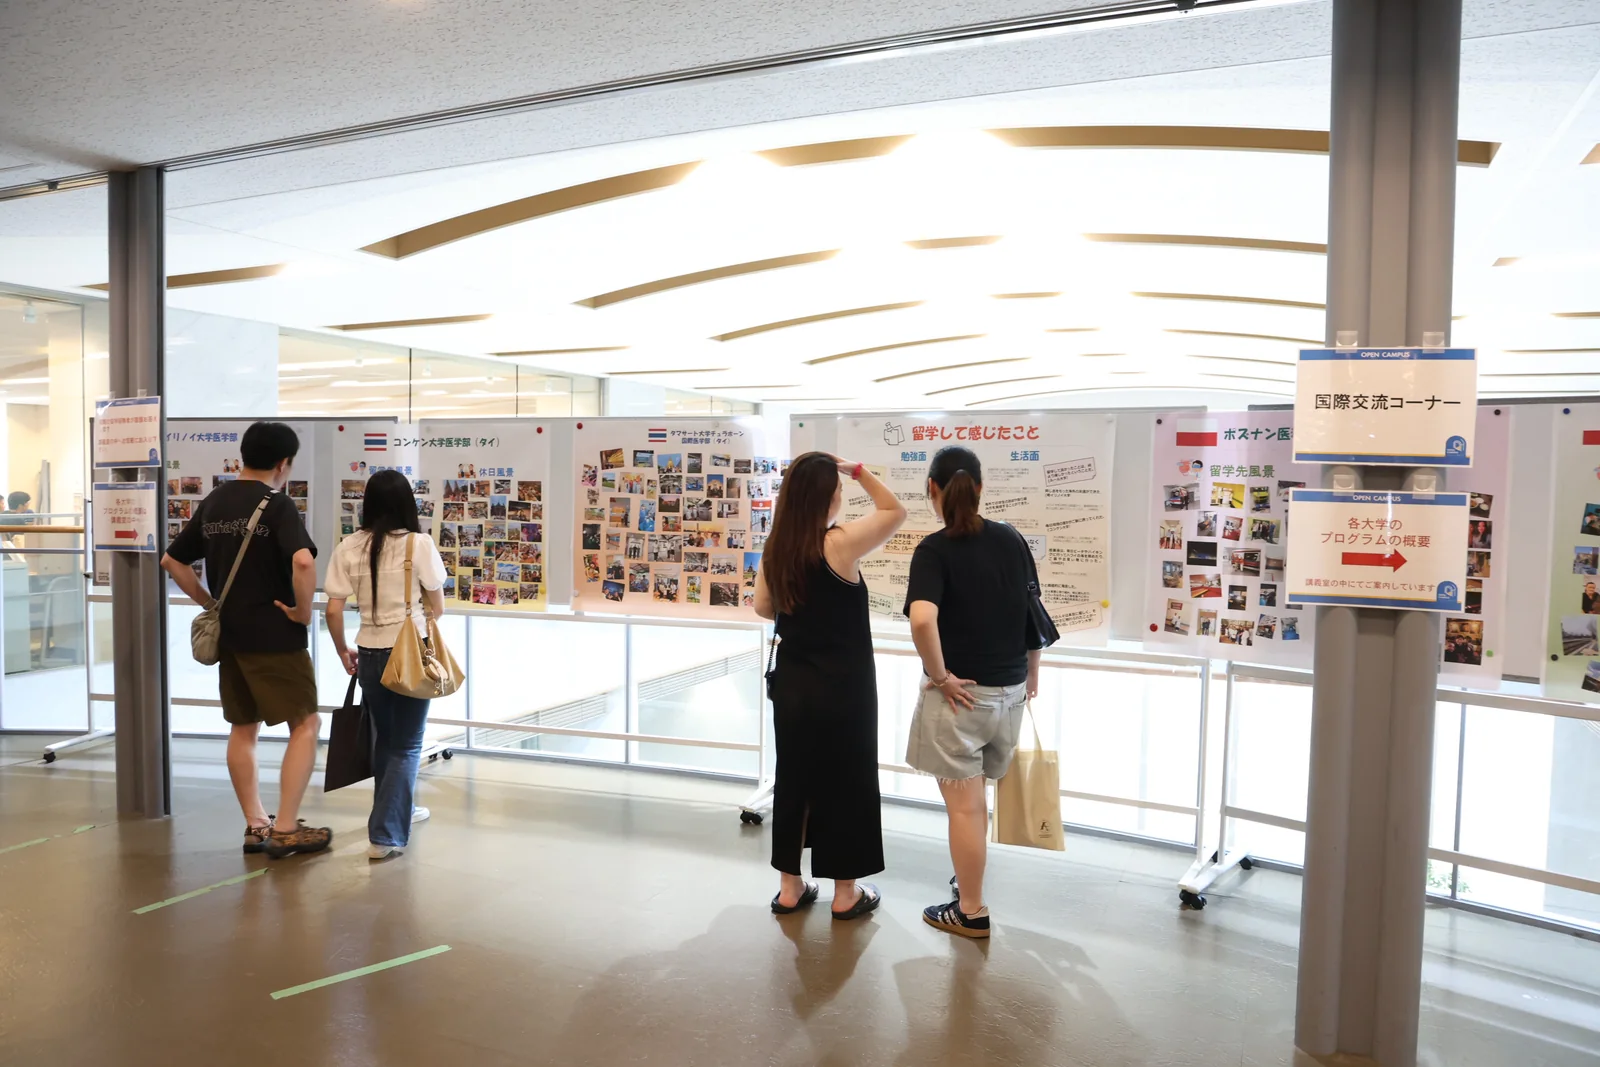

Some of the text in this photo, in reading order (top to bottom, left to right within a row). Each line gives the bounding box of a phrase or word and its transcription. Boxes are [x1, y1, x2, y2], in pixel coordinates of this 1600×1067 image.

[1315, 393, 1461, 411] 国際交流コーナー
[912, 425, 1040, 441] 留学して感じたこと
[1224, 427, 1293, 441] ポズナン医
[901, 451, 927, 461] 勉強面
[1010, 451, 1040, 461] 生活面
[479, 467, 514, 477] 休日風景
[1209, 465, 1275, 478] 留学先風景
[1348, 517, 1403, 530] 各大学の
[1321, 531, 1431, 548] プログラムの概要
[1305, 578, 1436, 592] 講義室の中にてご案内しています
